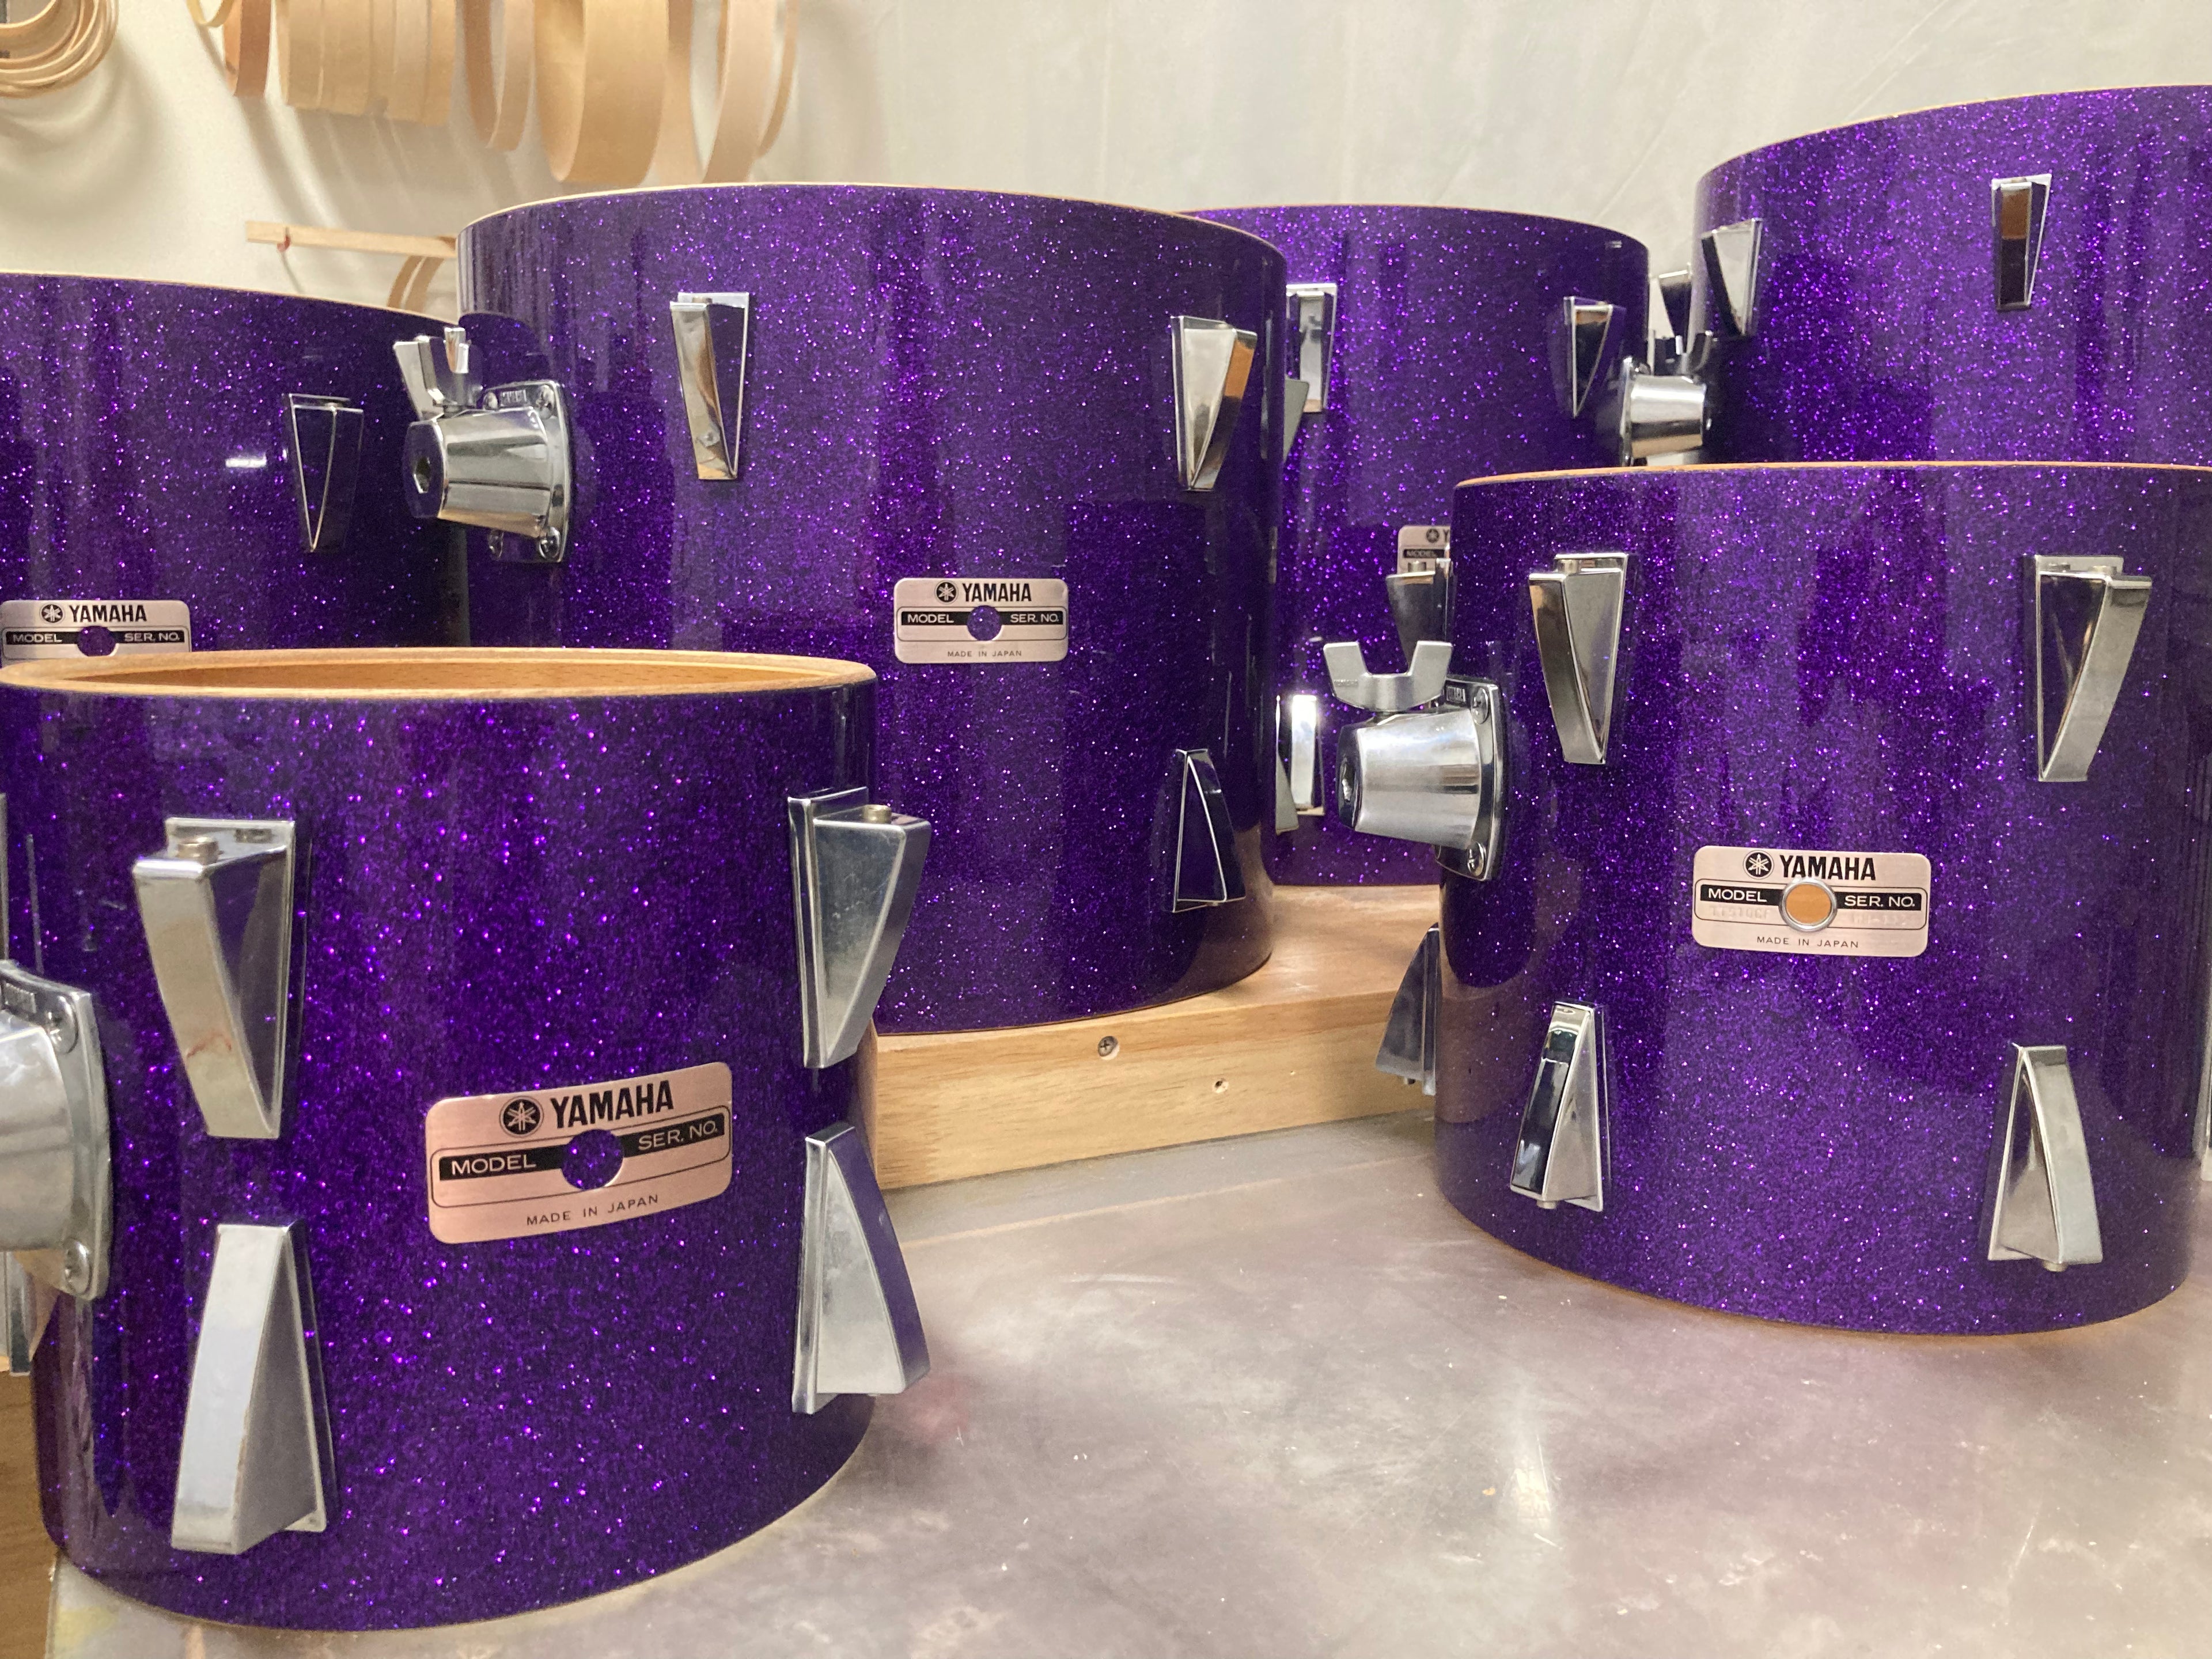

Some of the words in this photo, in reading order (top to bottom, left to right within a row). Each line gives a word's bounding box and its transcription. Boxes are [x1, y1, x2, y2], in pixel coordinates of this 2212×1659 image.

[963, 583, 1032, 602] YAMAHA
[69, 604, 147, 622] YAMAHA
[908, 613, 954, 623] MODEL
[1040, 613, 1059, 623] NO.
[13, 633, 62, 643] MODEL
[159, 632, 180, 641] NO.
[1780, 855, 1876, 881] YAMAHA
[1708, 888, 1767, 902] MODEL
[1844, 895, 1884, 907] SER.
[1888, 896, 1915, 907] NO.
[1757, 937, 1789, 945] MADE
[1817, 939, 1859, 948] JAPAN
[550, 1080, 673, 1129] YAMAHA
[638, 1131, 684, 1151] SER.
[689, 1120, 718, 1139] NO.
[452, 1154, 536, 1175] MODEL
[527, 1211, 571, 1226] MADE
[583, 1206, 597, 1217] IN
[607, 1195, 658, 1212] JAPAN
